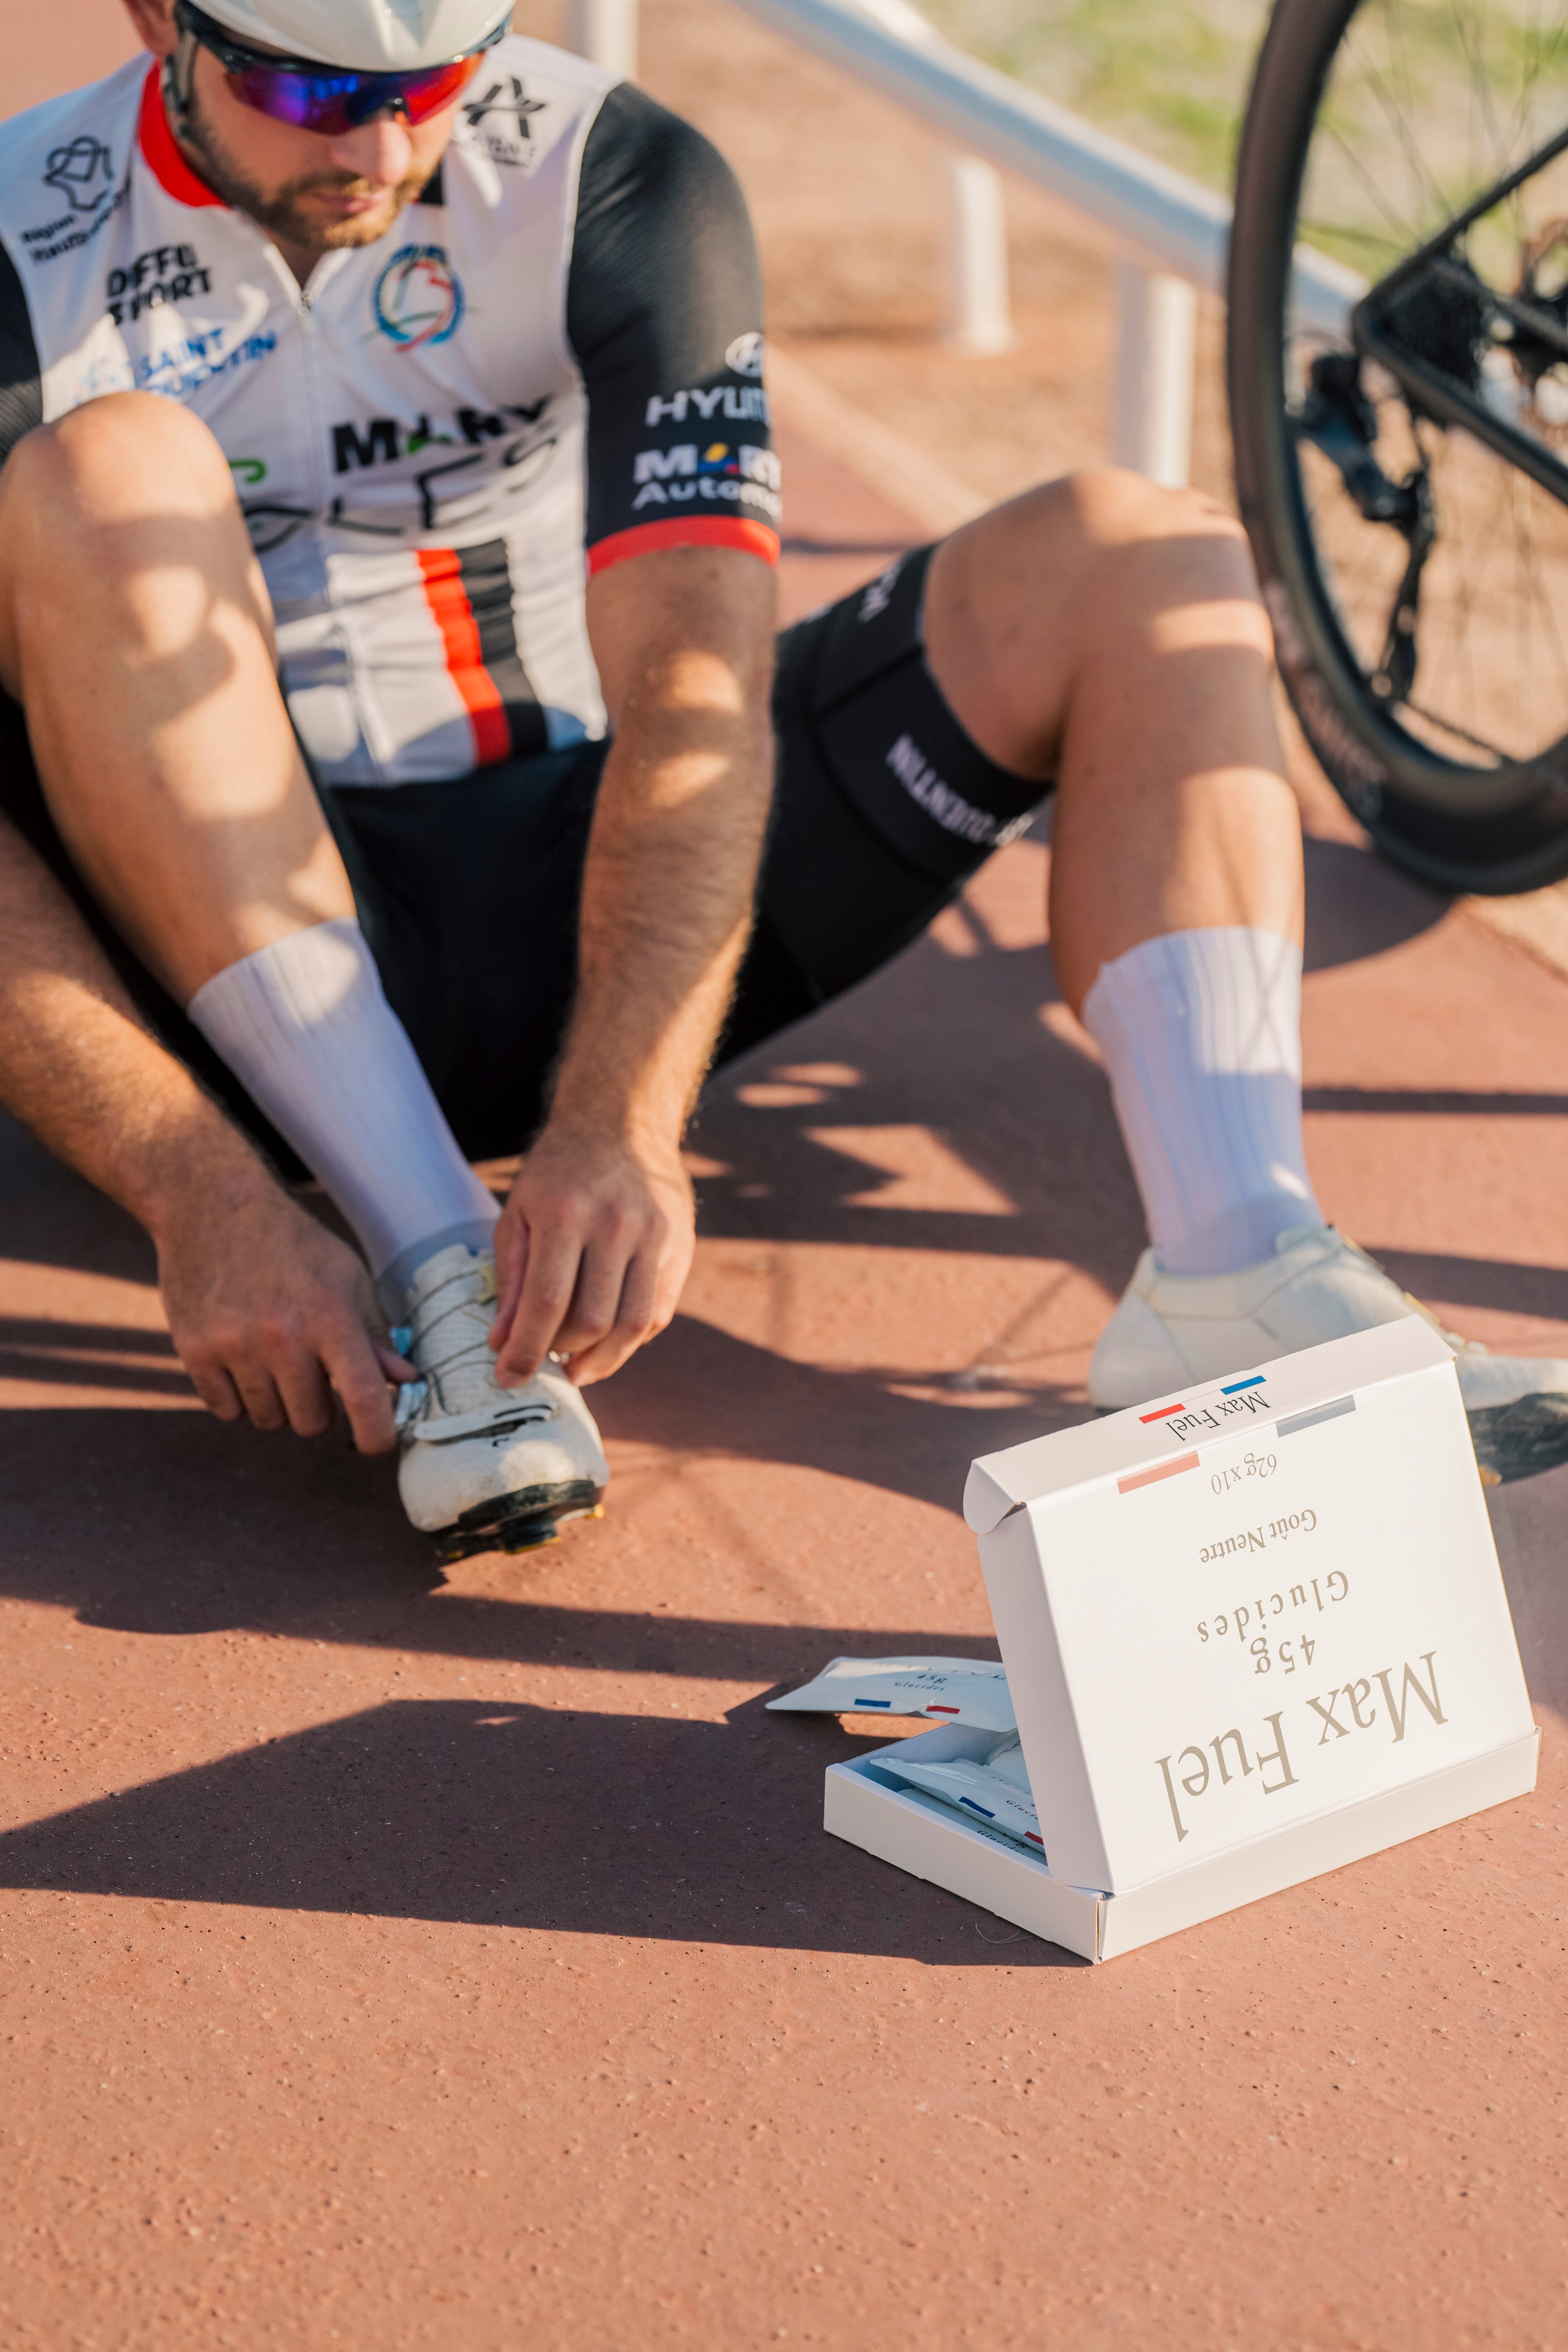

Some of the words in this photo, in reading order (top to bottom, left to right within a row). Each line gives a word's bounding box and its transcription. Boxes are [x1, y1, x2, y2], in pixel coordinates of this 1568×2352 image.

[1214, 1391, 1272, 1417] Max
[1165, 1408, 1222, 1441] Fuel
[1211, 1466, 1242, 1495] x10
[1243, 1452, 1277, 1479] 62g
[1269, 1509, 1317, 1541] Goût
[1199, 1526, 1267, 1563] Neutre
[1197, 1570, 1350, 1643] Glucides
[1250, 1634, 1316, 1675] 45g
[894, 1681, 945, 1691] Glucides
[1305, 1650, 1449, 1746] Max
[1154, 1711, 1300, 1843] Fuel
[977, 1830, 1024, 1855] Glucid
